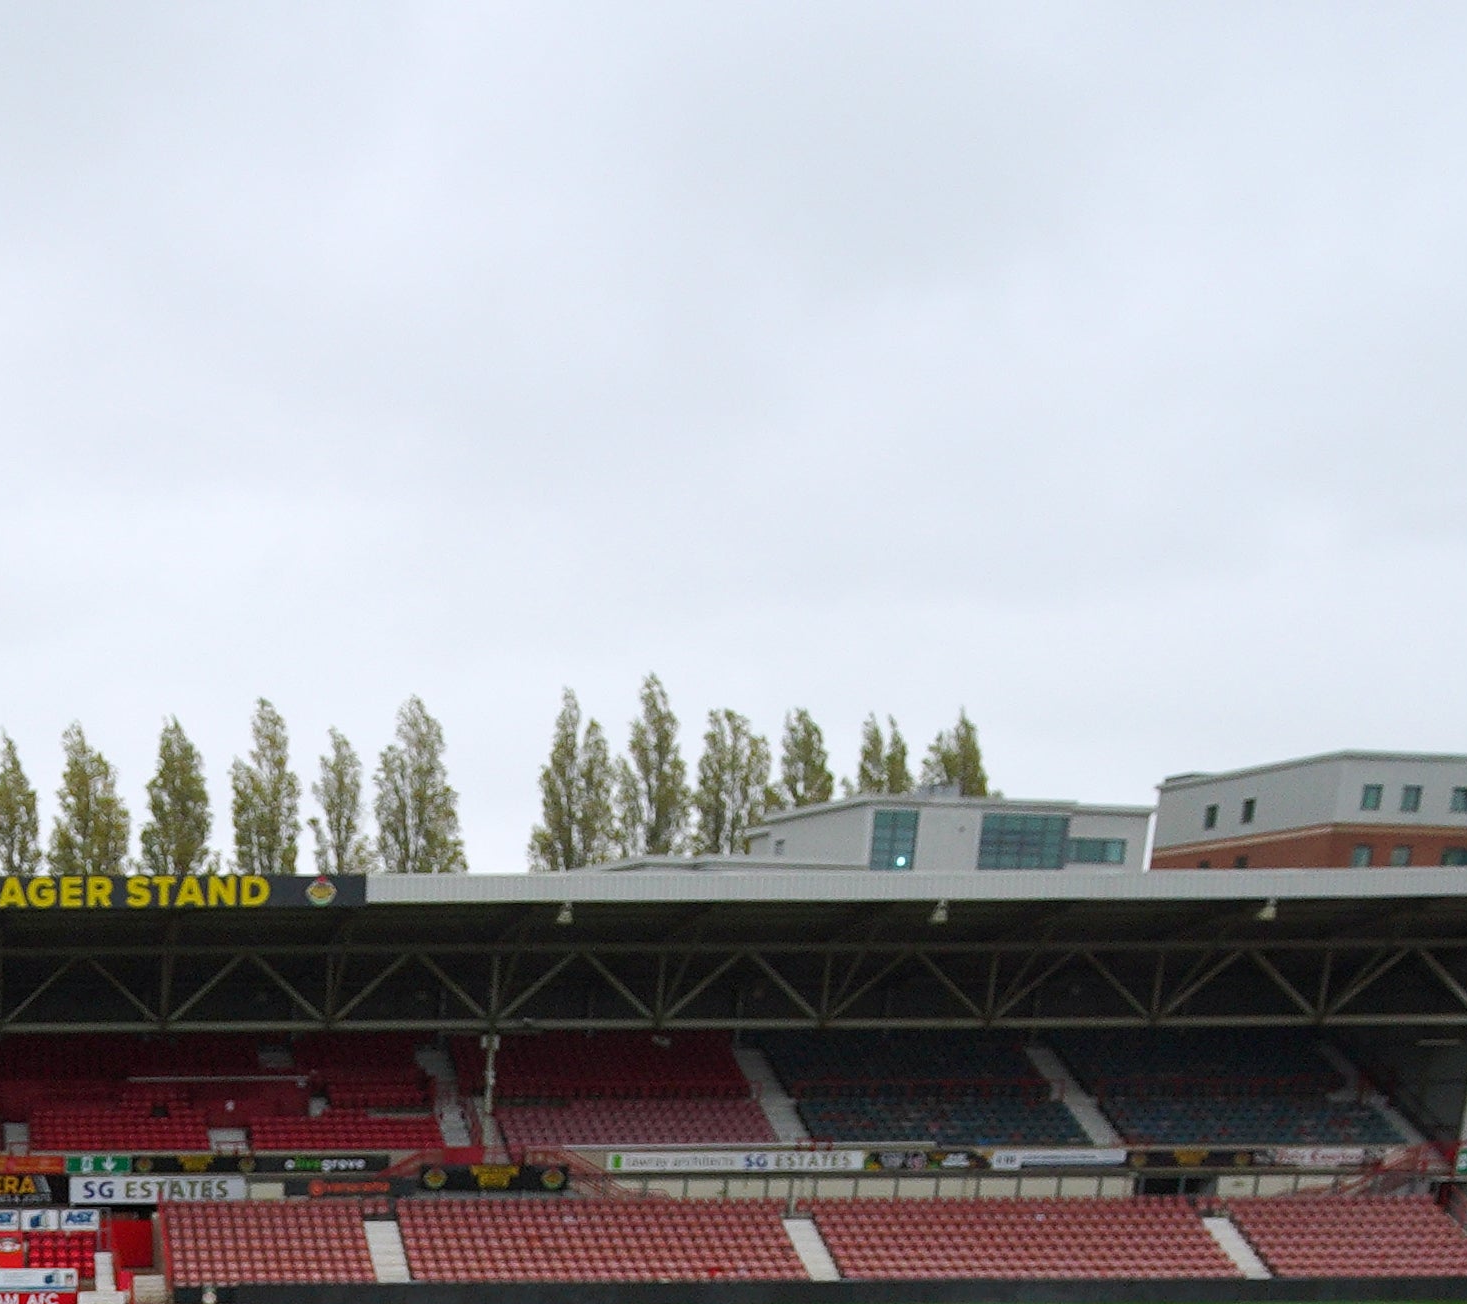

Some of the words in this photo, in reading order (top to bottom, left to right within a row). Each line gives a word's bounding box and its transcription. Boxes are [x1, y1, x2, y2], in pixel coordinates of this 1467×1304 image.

[126, 875, 271, 908] STAND
[774, 1153, 852, 1169] ESTATES
[82, 1180, 114, 1199] SG
[125, 1179, 229, 1199] ESTATES
